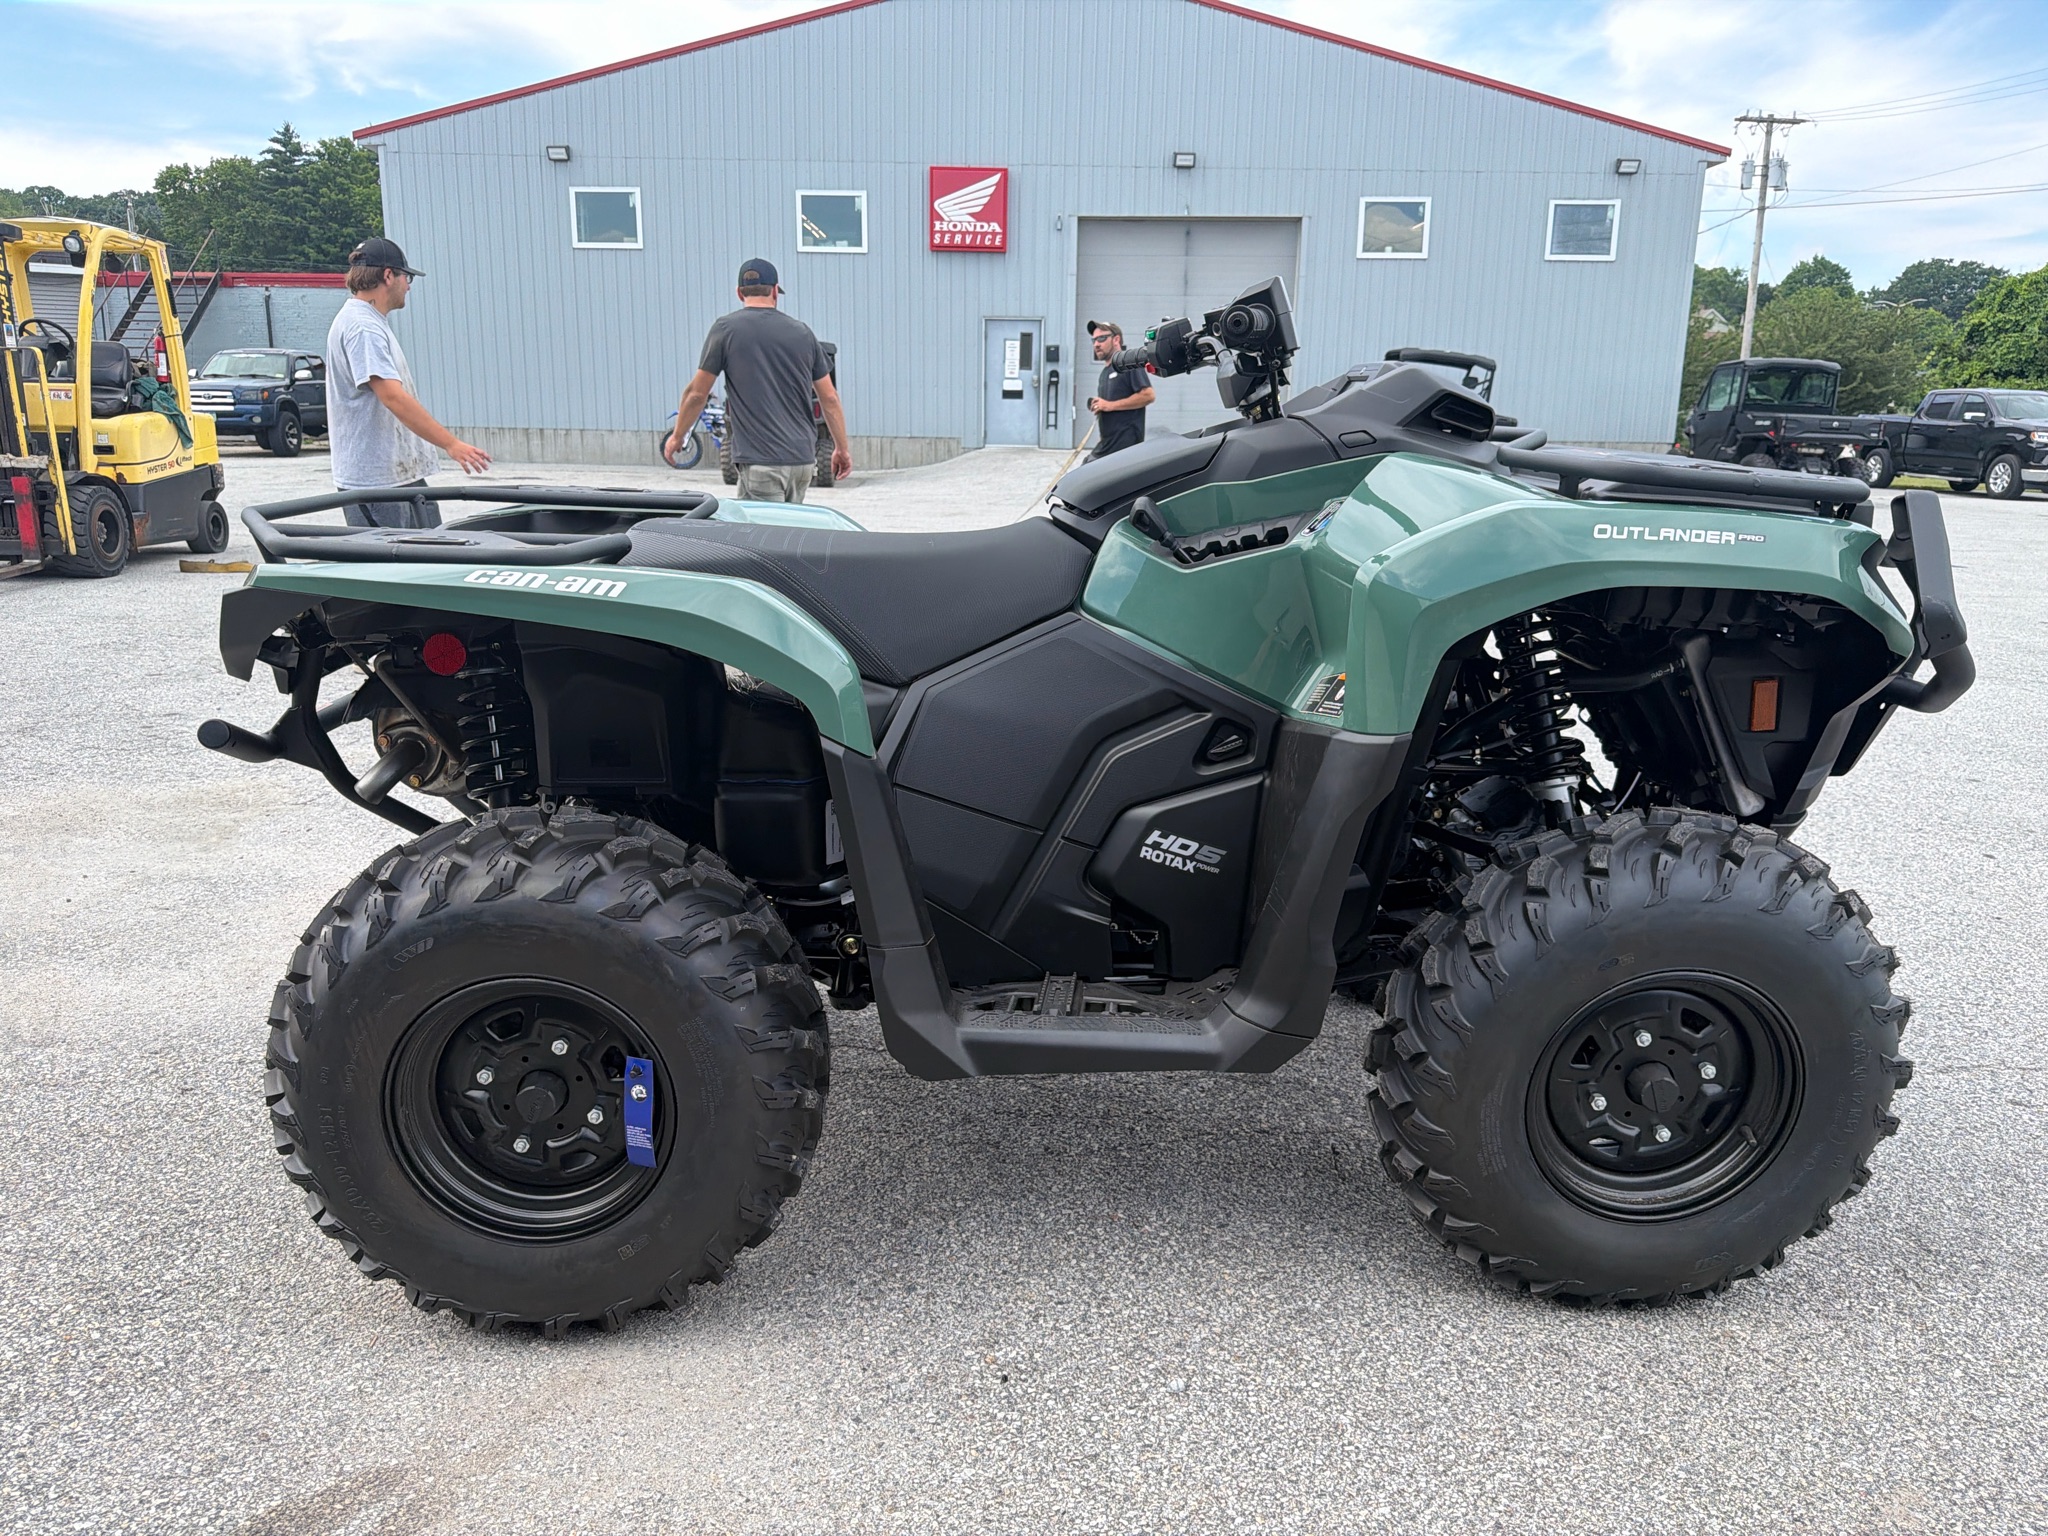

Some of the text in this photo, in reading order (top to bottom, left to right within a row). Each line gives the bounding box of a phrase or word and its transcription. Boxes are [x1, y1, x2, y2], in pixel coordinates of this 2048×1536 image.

[933, 221, 1002, 232] HONDA
[933, 233, 1003, 246] SERVICE
[146, 460, 175, 475] HYSTER 50
[1593, 523, 1765, 545] OUTLANDER PRO
[463, 569, 628, 598] can-am
[1139, 846, 1220, 874] ROTAX POWER
